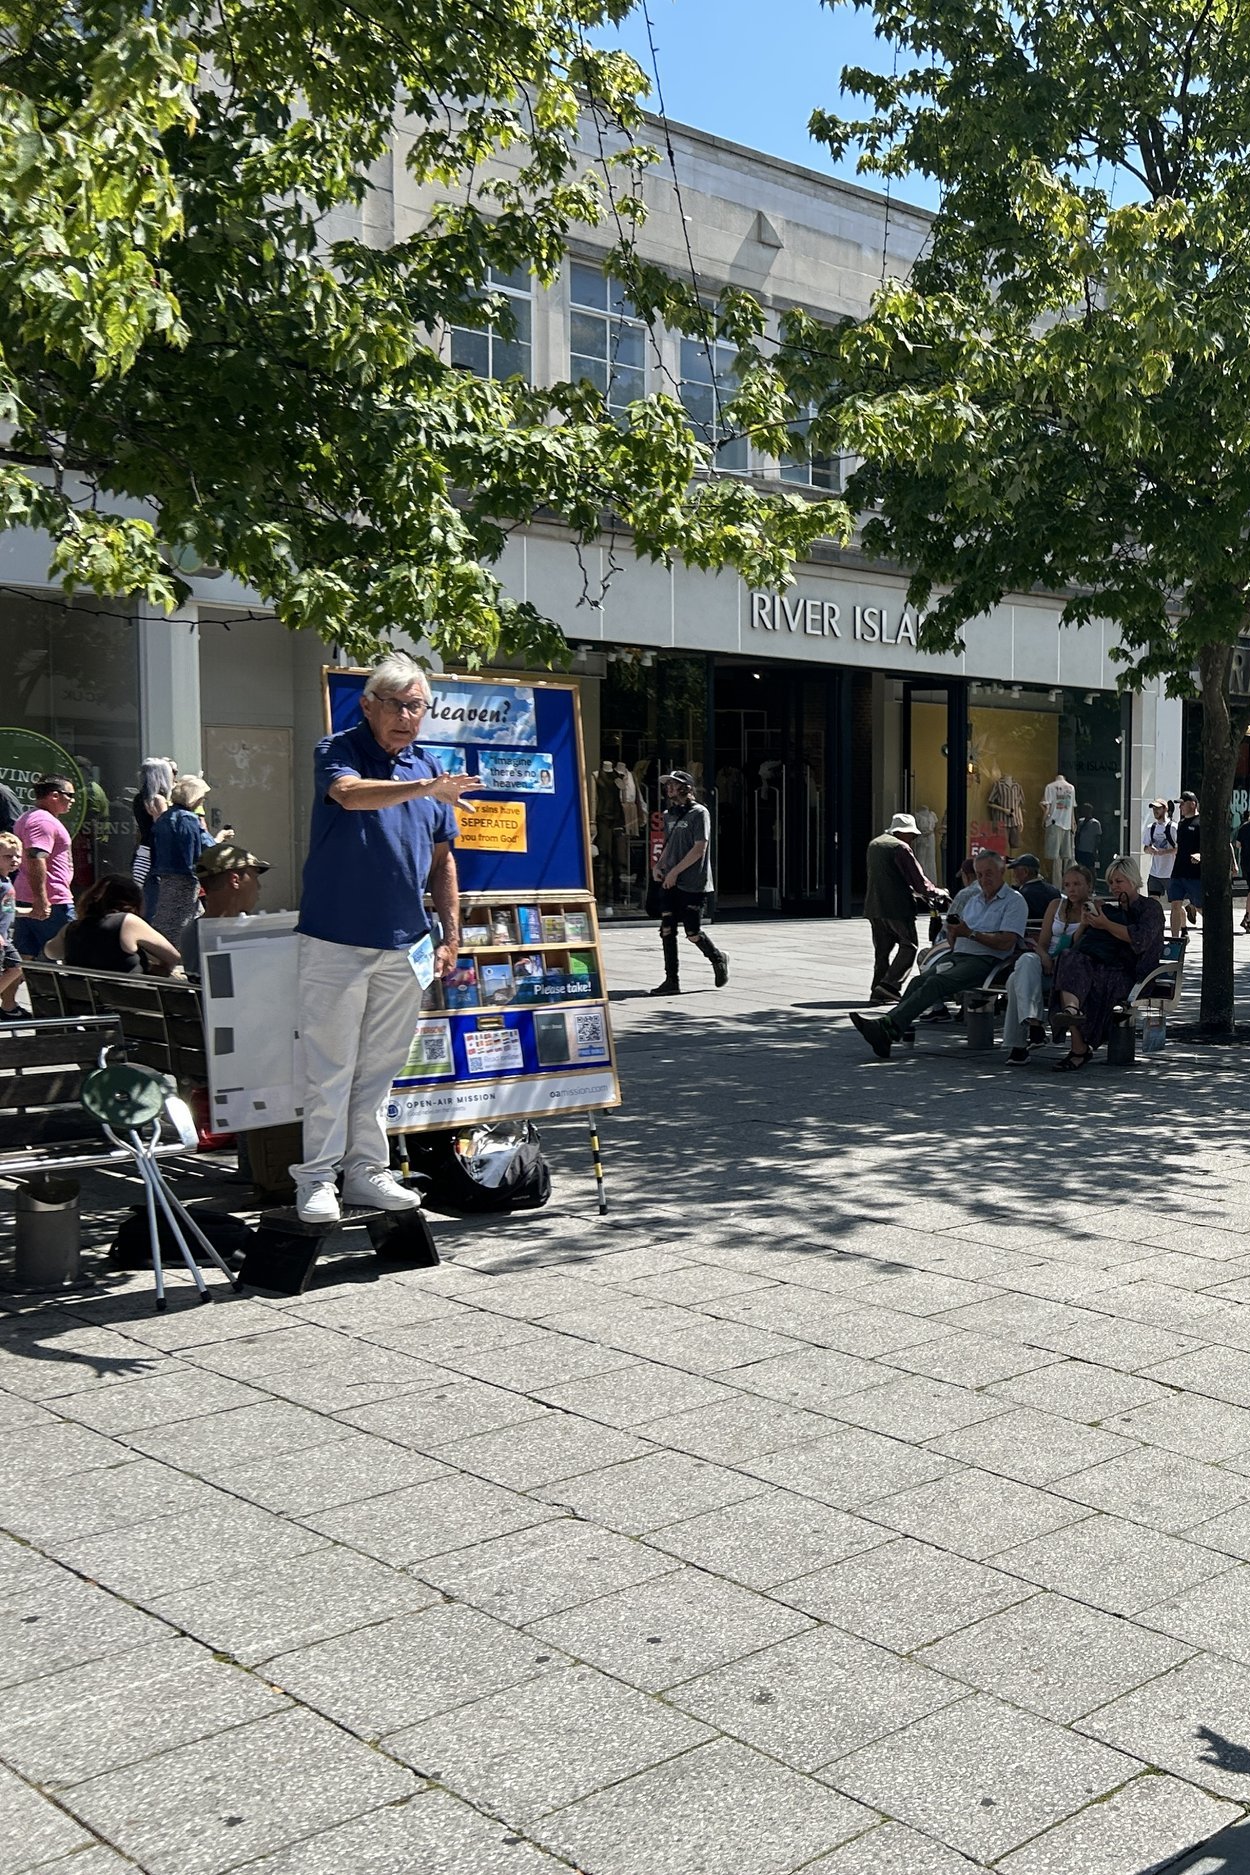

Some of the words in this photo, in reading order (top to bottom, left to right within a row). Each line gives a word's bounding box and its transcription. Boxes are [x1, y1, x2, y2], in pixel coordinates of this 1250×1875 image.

[751, 592, 842, 638] RIVER
[854, 605, 926, 646] ISLA
[524, 770, 537, 778] no
[480, 805, 499, 814] sins
[500, 806, 521, 815] have
[461, 817, 519, 830] SEPERATED
[460, 834, 477, 843] you
[478, 833, 499, 843] from
[533, 984, 566, 996] Please
[566, 981, 592, 993] take!
[406, 1096, 453, 1109] OPEN-AIR
[457, 1092, 496, 1104] MISSION
